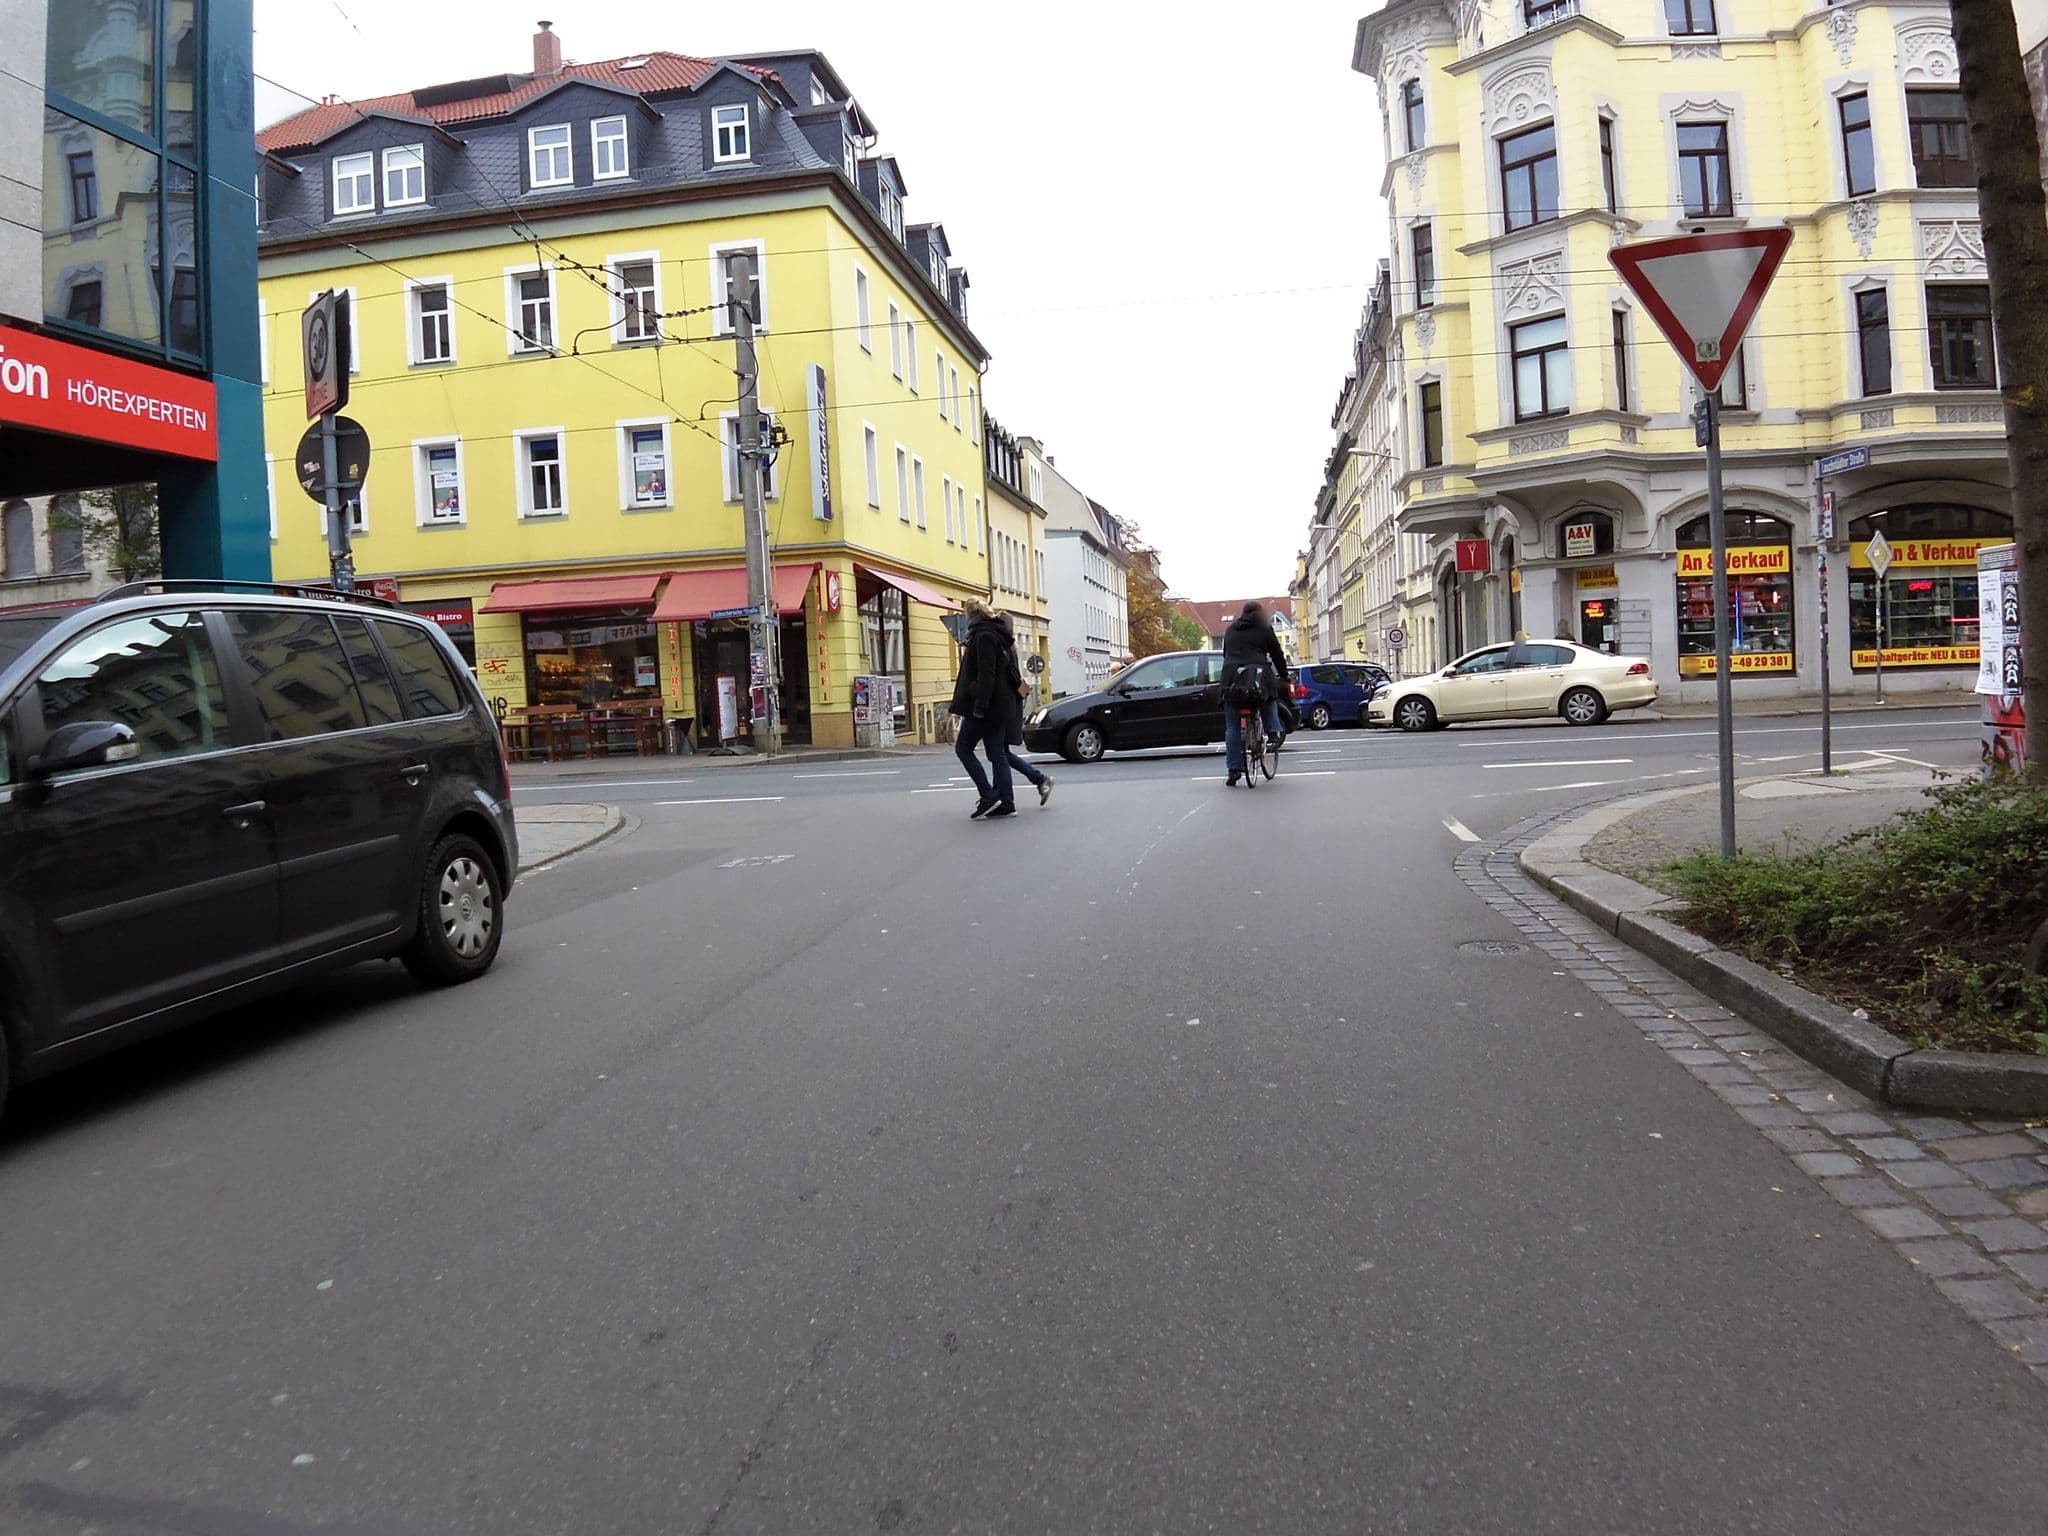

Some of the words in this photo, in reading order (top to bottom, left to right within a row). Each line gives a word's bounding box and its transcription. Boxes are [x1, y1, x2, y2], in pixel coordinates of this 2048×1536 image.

[0, 345, 49, 400] on
[67, 378, 207, 431] HÖREXPERTEN
[1567, 525, 1592, 540] A&V
[1907, 545, 1918, 561] &
[1682, 554, 1702, 571] An
[437, 613, 463, 621] Bistro
[1931, 650, 1948, 660] NEU
[1950, 649, 1957, 660] &
